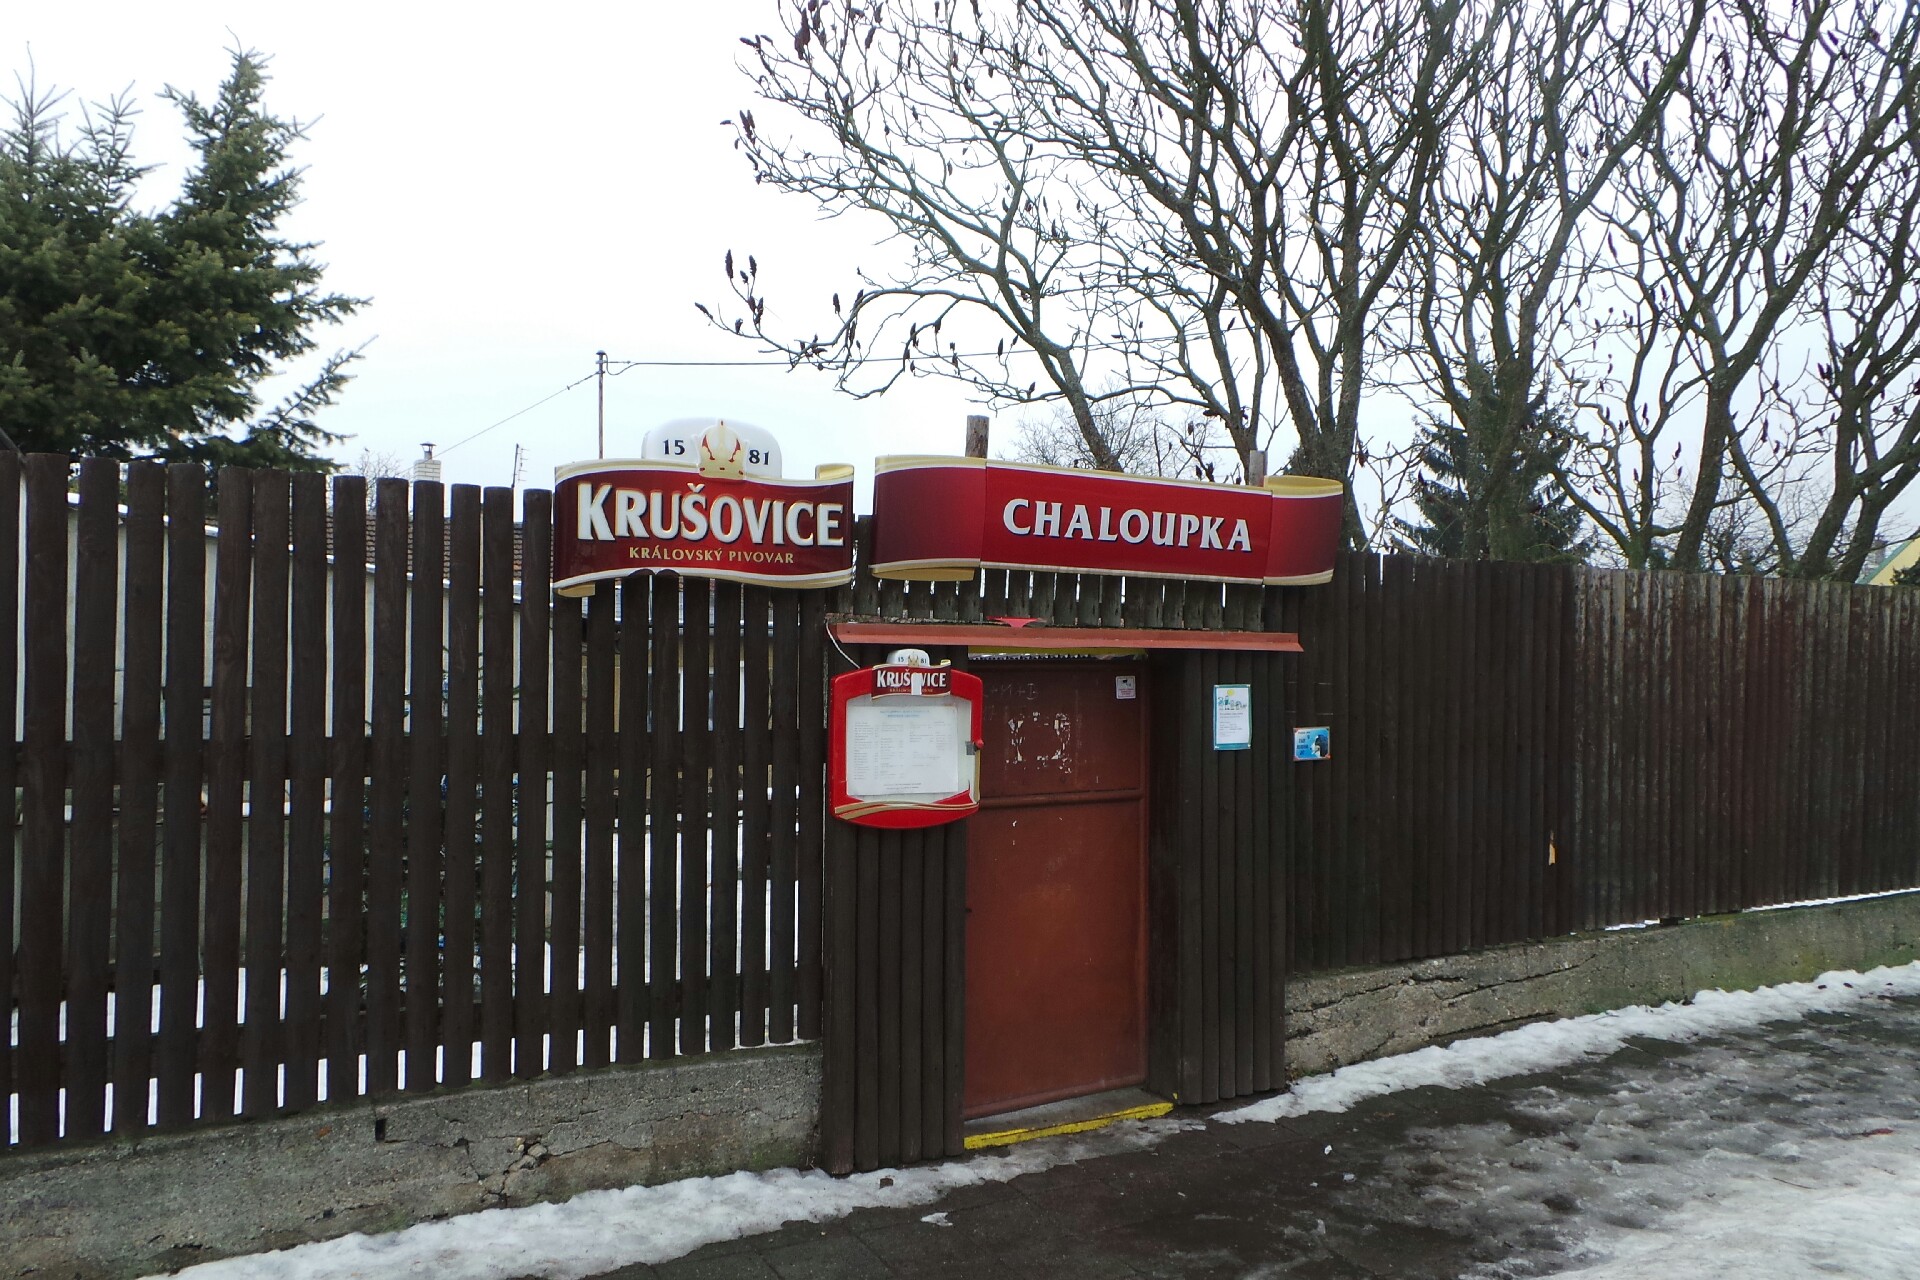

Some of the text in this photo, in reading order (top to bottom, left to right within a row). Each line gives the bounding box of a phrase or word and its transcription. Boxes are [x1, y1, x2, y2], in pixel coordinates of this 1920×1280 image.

[662, 439, 770, 466] 15 81
[577, 482, 845, 547] KRUŠOVICE
[1002, 498, 1252, 553] CHALOUPKA
[629, 545, 794, 564] KRÁLOVSKÝ PIVOVAR
[876, 668, 947, 688] KRUŠVICE
